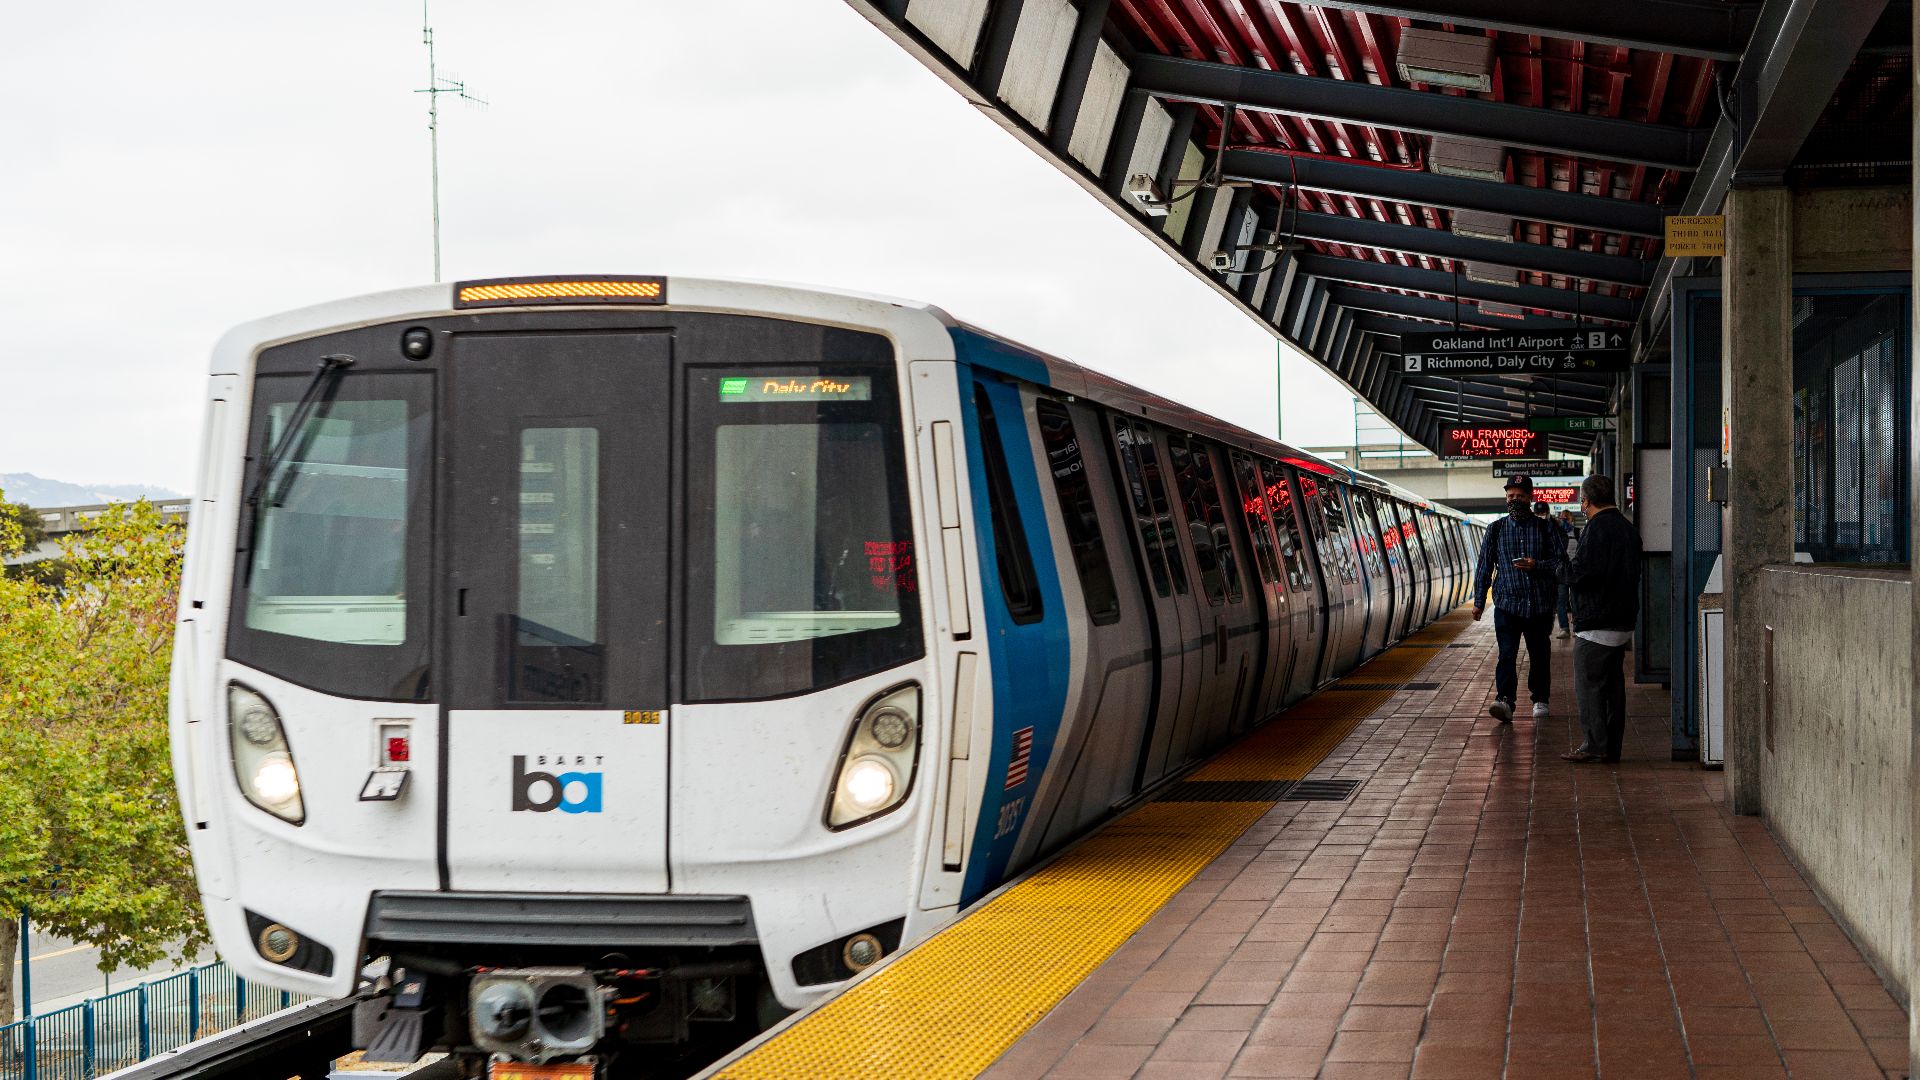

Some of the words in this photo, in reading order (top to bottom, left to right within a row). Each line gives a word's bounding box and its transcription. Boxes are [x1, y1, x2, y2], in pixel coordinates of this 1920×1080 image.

[1672, 230, 1699, 238] THIRD
[1432, 337, 1485, 350] Oakland
[1489, 336, 1514, 349] Int'l
[1518, 336, 1565, 350] Airport
[1592, 334, 1602, 346] 3
[1408, 357, 1418, 370] 2
[1427, 355, 1493, 369] Richmond,
[1497, 355, 1526, 369] Daly
[1529, 354, 1555, 369] City
[762, 380, 807, 394] Daly
[810, 379, 850, 393] City
[1569, 419, 1586, 428] Exit
[1452, 429, 1474, 440] SAN
[1472, 438, 1501, 448] DALY
[1504, 438, 1528, 448] CITY
[1514, 475, 1523, 484] B
[537, 755, 604, 766] BART
